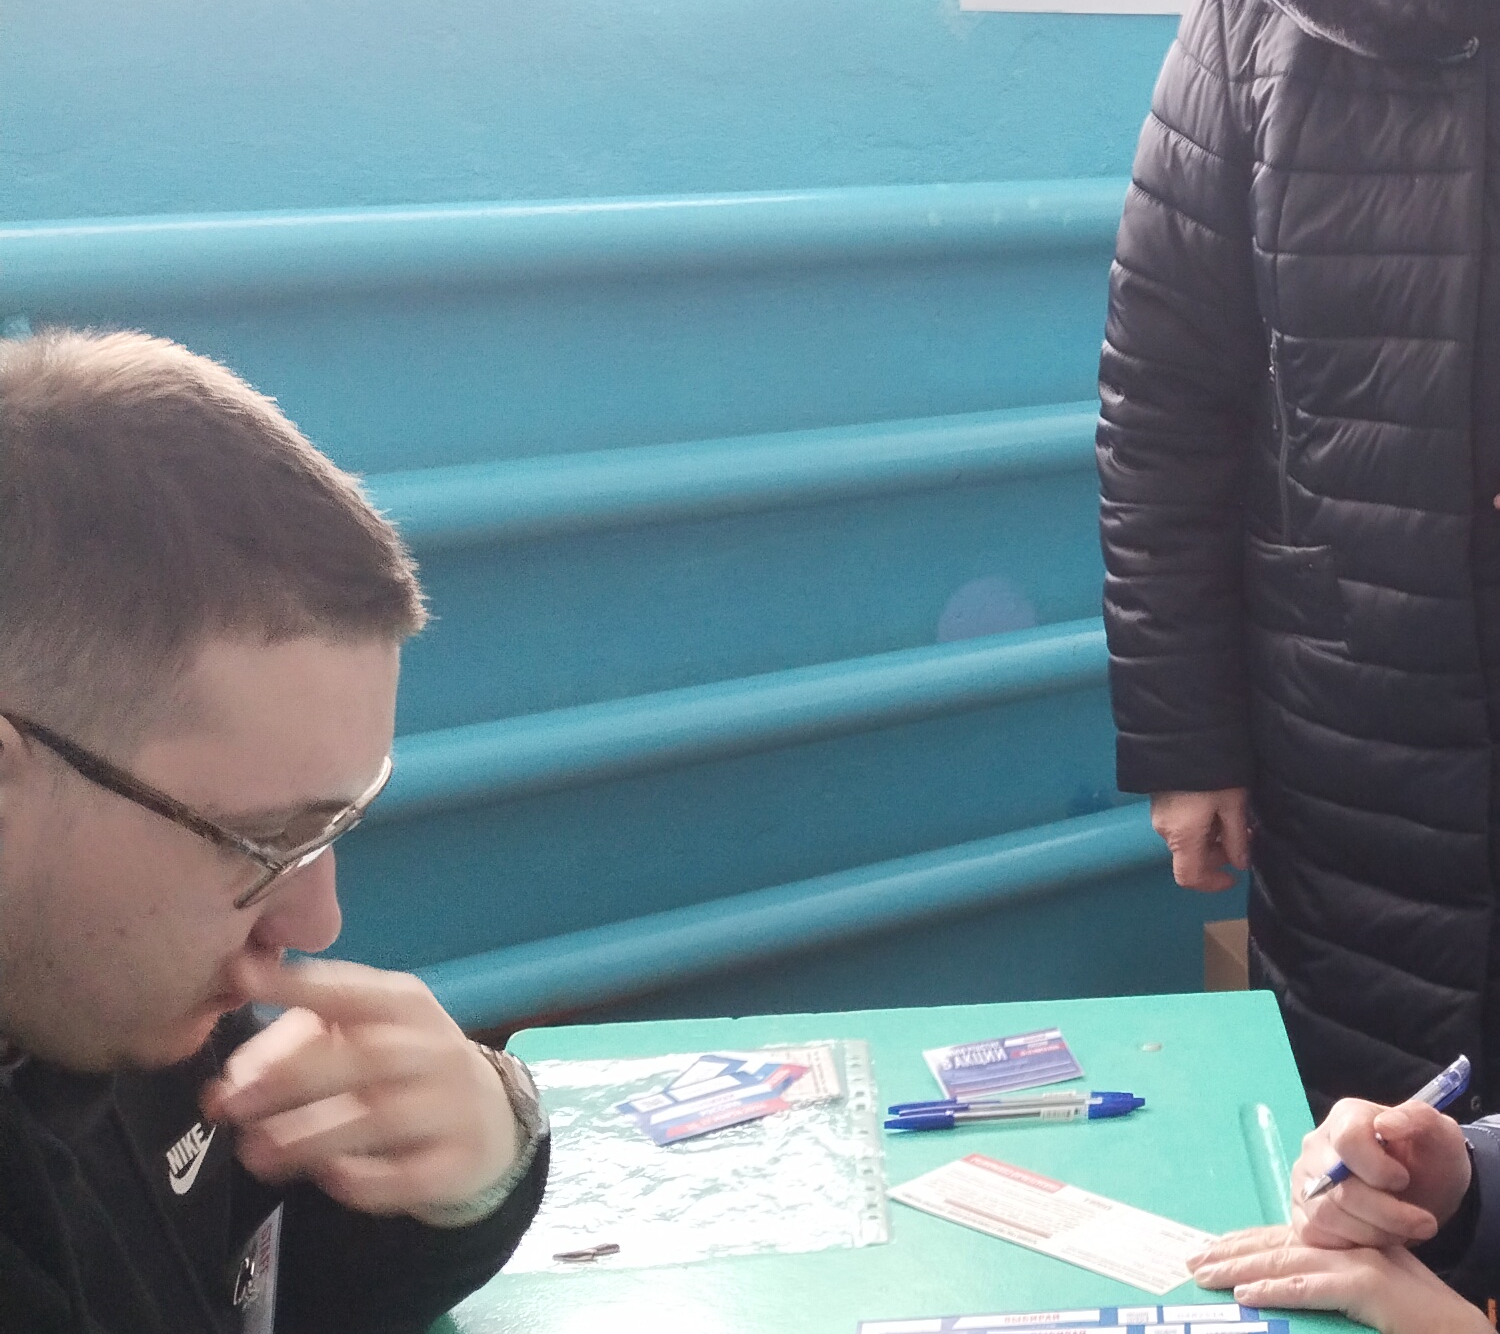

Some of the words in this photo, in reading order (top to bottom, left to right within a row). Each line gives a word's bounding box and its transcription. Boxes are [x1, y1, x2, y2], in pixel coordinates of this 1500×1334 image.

[955, 1046, 1008, 1069] АКЦИИ
[165, 1122, 205, 1175] NIKE
[1004, 1313, 1060, 1324] ВЫБИРАЙ
